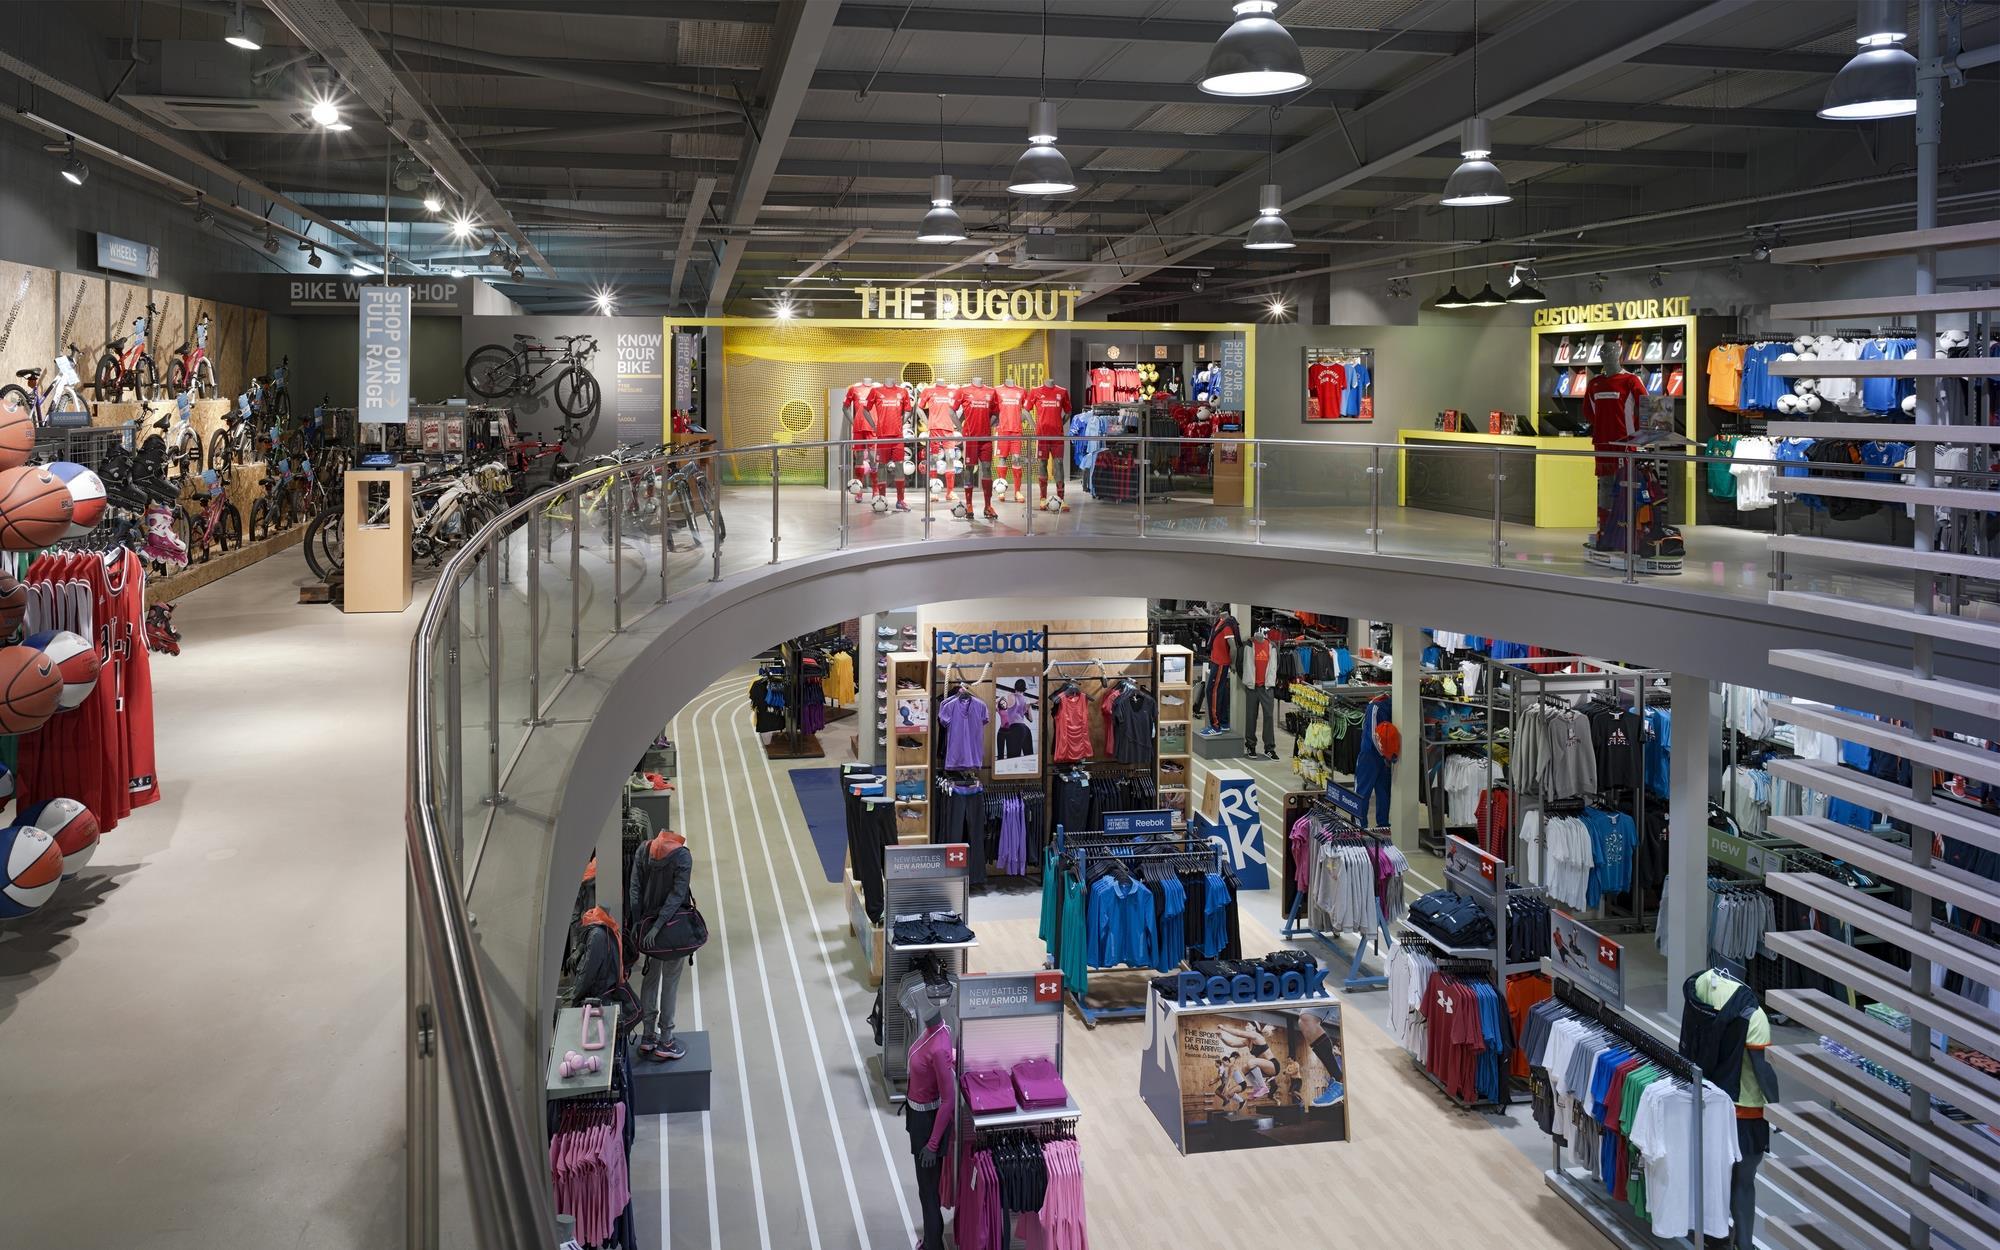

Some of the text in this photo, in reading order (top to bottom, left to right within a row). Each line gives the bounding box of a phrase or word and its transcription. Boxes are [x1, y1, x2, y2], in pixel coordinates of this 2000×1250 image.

[109, 241, 137, 262] WHEELS
[290, 282, 337, 300] BIKE
[854, 287, 1082, 321] THE DUGOUT
[1534, 303, 1614, 326] CUSTOMISE
[1614, 299, 1659, 321] YOUR
[1662, 296, 1690, 317] KIT
[384, 291, 402, 385] SHOP OUR
[617, 334, 662, 347] KNOW
[366, 292, 383, 409] FULL RANGE
[617, 347, 655, 360] YOUR
[1671, 340, 1682, 357] 9
[617, 361, 651, 374] BIKE
[1223, 341, 1233, 403] FULL RANGE
[1233, 341, 1244, 391] SHOP OUR
[1560, 378, 1569, 394] 8
[1670, 375, 1683, 394] 7
[937, 629, 1046, 655] Reebok
[1135, 819, 1165, 827] Reebok
[1711, 837, 1740, 857] new
[911, 862, 941, 870] ARMOUR
[969, 986, 1028, 997] NEW BATTLES
[1178, 963, 1330, 1008] Reebok
[969, 995, 1028, 1006] NEW ARMOUR
[1184, 1043, 1199, 1051] HAS
